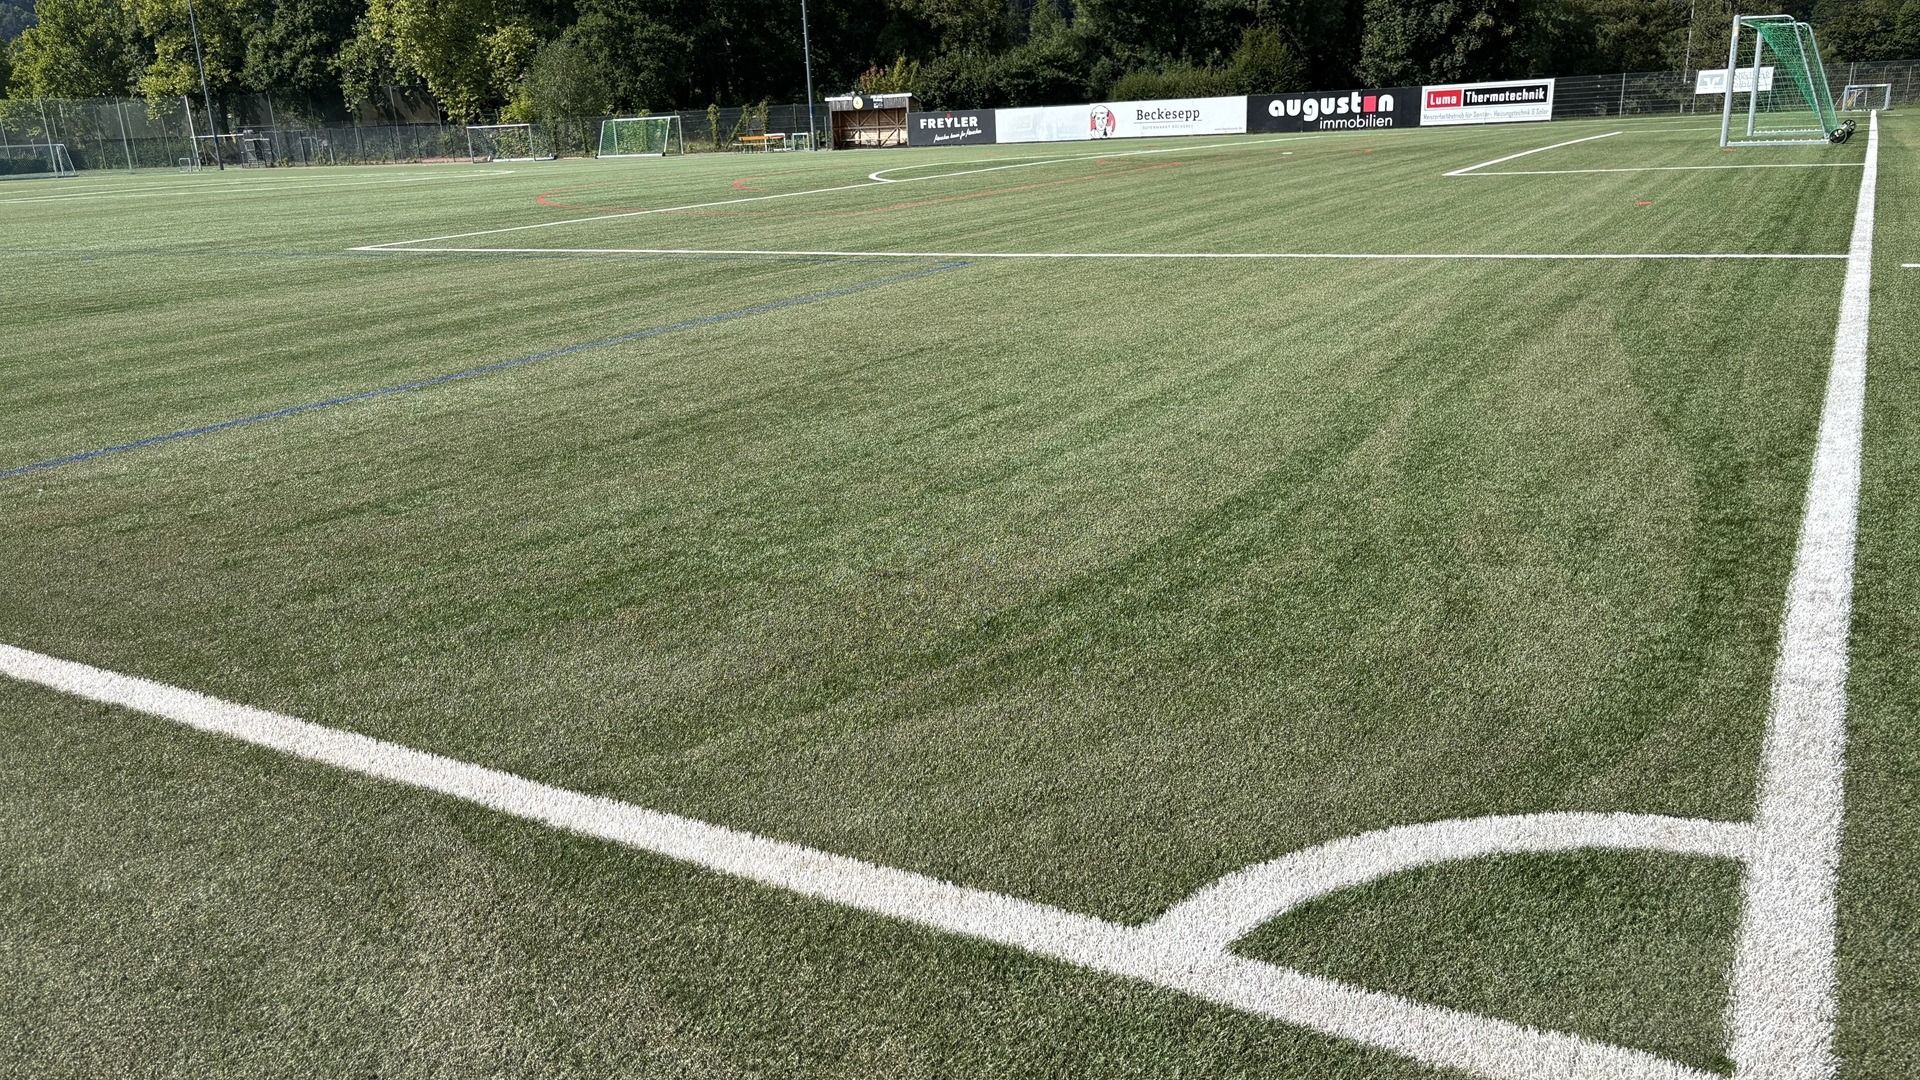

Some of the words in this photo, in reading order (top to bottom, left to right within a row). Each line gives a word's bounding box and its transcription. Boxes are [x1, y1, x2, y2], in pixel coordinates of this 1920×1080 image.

[1429, 94, 1457, 105] Luma
[1466, 87, 1545, 104] Thermotechnik
[920, 116, 978, 129] FREYLER
[1319, 114, 1393, 129] immobilien
